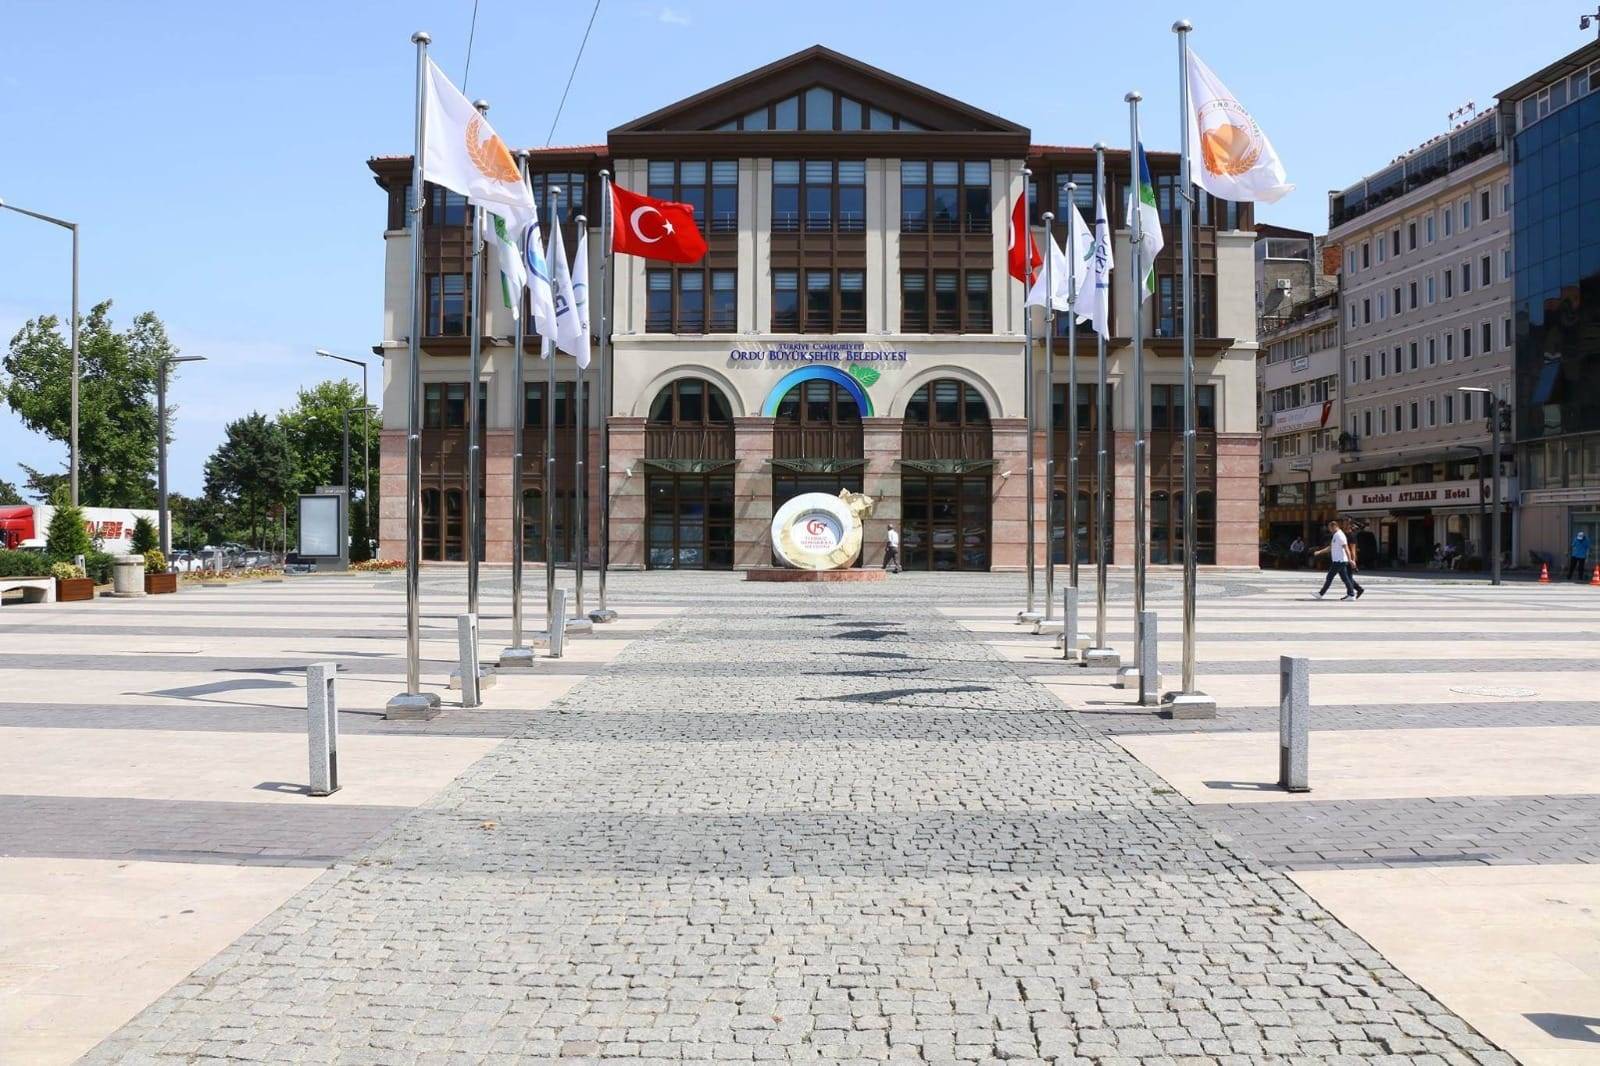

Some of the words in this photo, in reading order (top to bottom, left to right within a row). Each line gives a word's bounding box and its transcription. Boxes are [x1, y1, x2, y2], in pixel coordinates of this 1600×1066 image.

[730, 350, 765, 361] ORDU
[769, 349, 840, 363] BÜYÜKŞEHİR
[846, 350, 907, 361] BELEDİYESİ
[1398, 490, 1437, 502] ATLIHAN
[1445, 488, 1470, 499] Hotel
